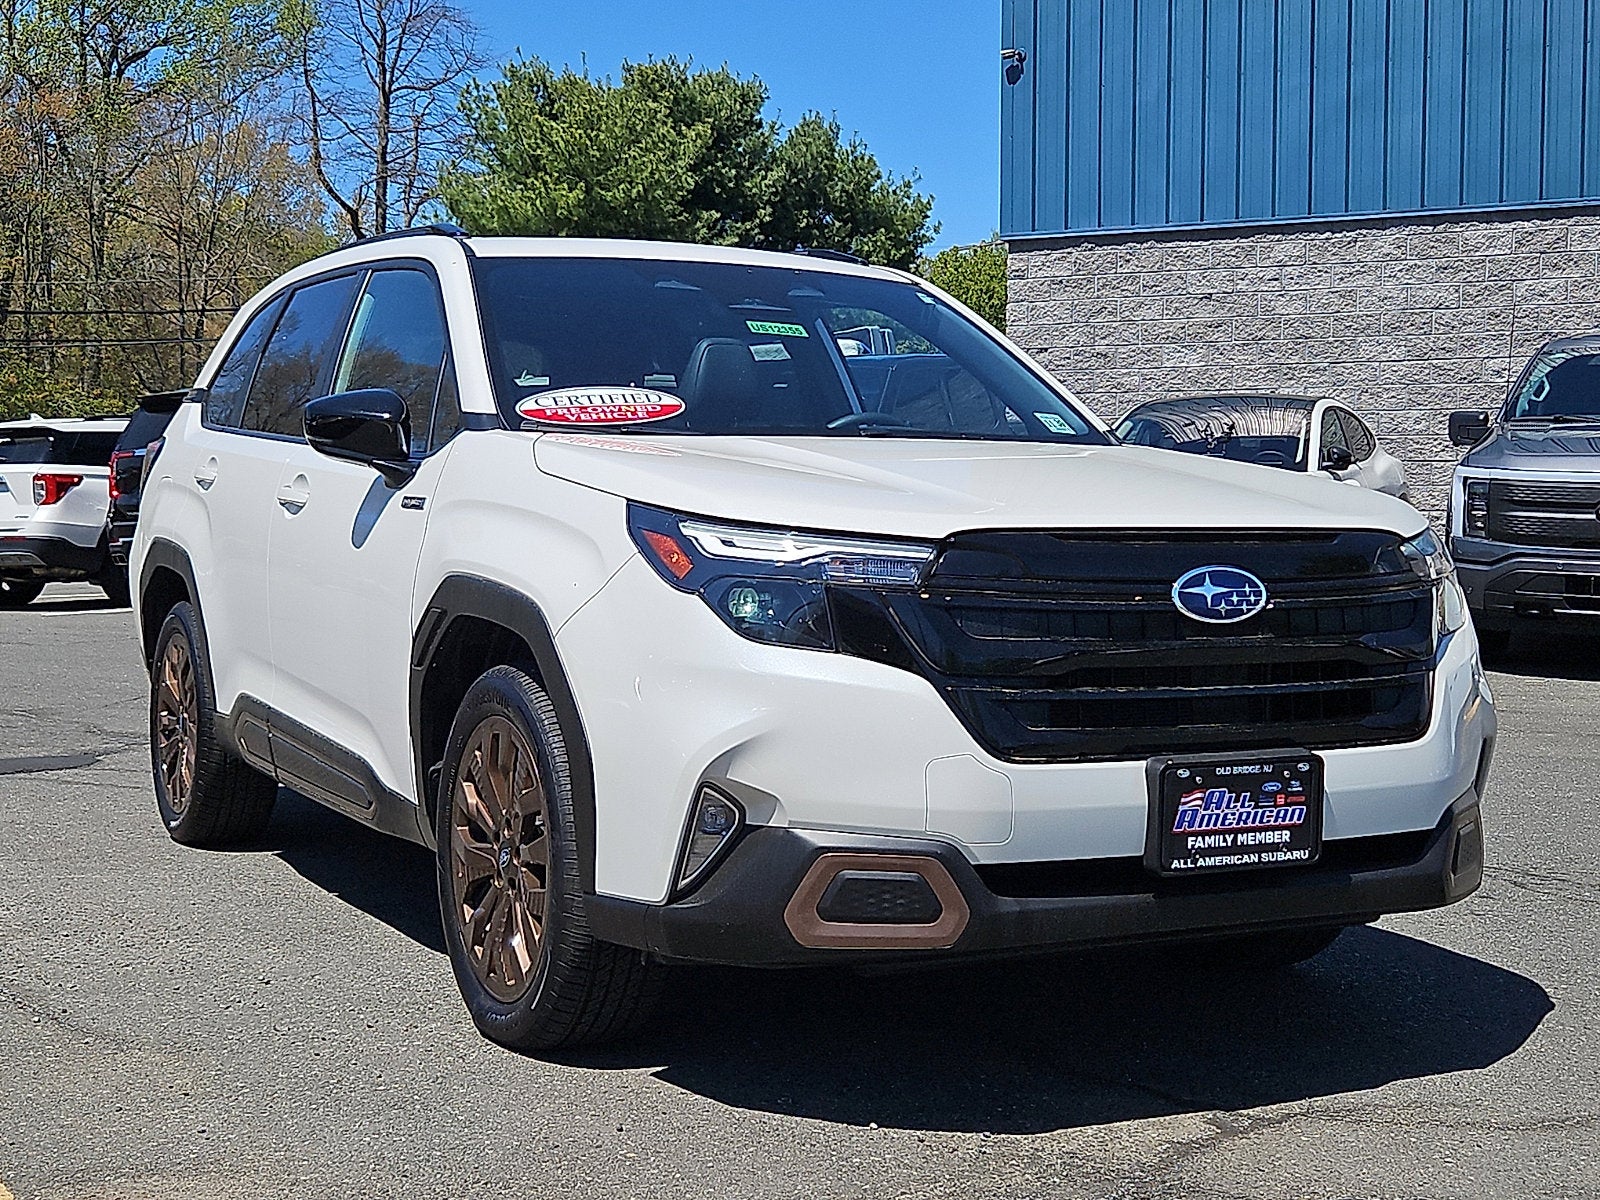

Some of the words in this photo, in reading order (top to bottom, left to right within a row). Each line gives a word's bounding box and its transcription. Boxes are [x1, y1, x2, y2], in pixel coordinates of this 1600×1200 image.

[534, 392, 662, 407] CERTIFIED
[545, 404, 662, 416] PRE-OWNED
[565, 411, 649, 421] VEHICLE
[1216, 767, 1231, 775] OLD
[1263, 764, 1273, 773] NJ
[1203, 788, 1254, 811] ALL
[1172, 806, 1306, 831] AMERICAN
[1187, 834, 1235, 849] FAMILY
[1237, 830, 1290, 846] MEMBER
[1171, 858, 1195, 869] ALL
[1197, 853, 1259, 867] AMERICAN
[1261, 850, 1309, 863] SUBARU
